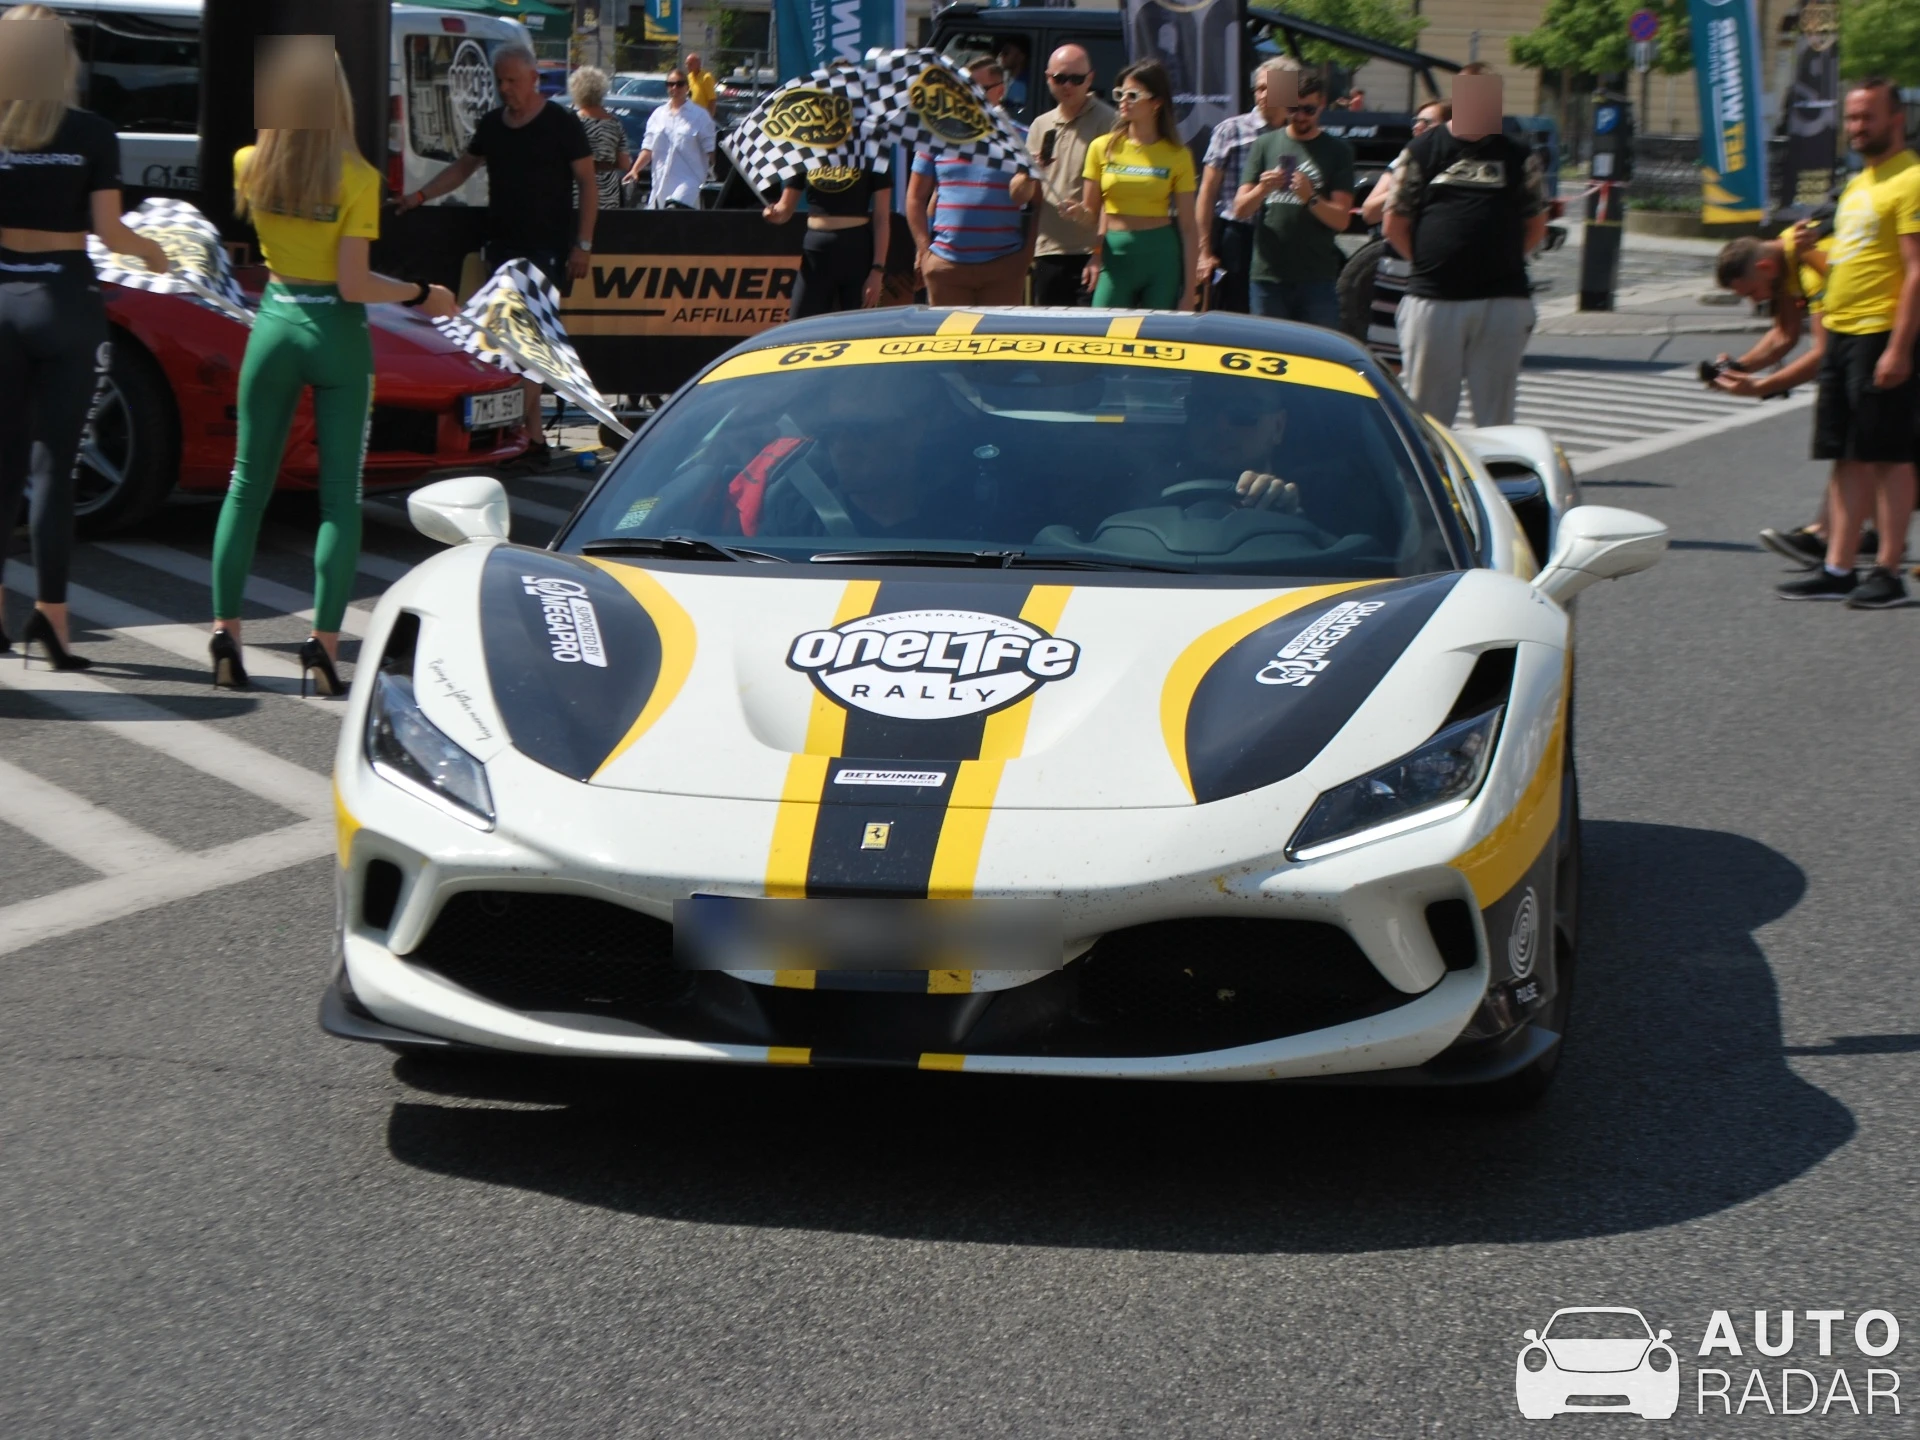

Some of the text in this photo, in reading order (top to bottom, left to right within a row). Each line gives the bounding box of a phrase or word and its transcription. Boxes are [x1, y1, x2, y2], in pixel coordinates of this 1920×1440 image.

[778, 342, 852, 366] 63
[1219, 352, 1289, 376] 63
[575, 605, 601, 657] SUPPORTED BY
[866, 612, 1020, 631] ONELIFERALLY.COM
[1287, 612, 1340, 651] SUPPORTED
[850, 684, 997, 702] RALLY
